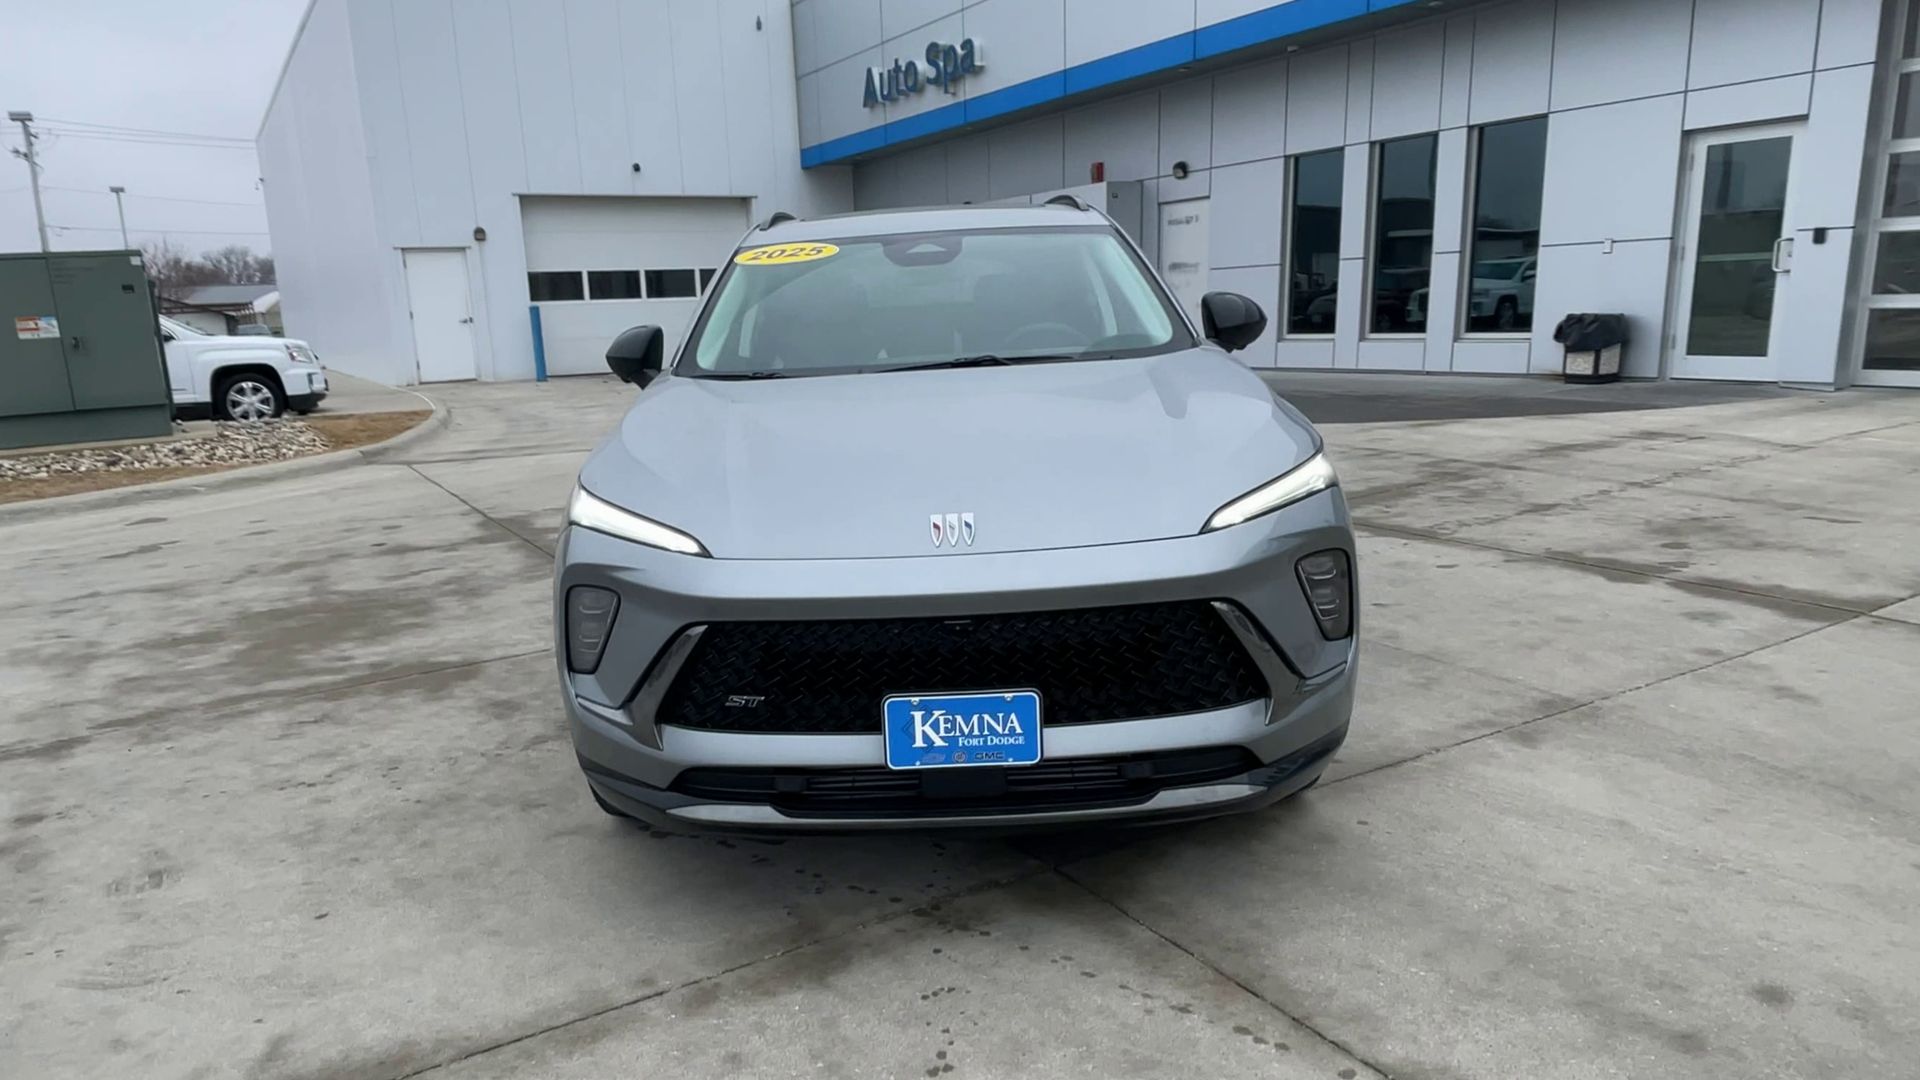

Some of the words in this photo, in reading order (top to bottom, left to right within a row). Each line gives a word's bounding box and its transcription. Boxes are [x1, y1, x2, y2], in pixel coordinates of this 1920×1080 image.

[863, 58, 922, 108] Auto
[926, 38, 984, 95] Spa
[749, 245, 828, 262] 2025
[725, 695, 765, 707] ST
[910, 710, 1023, 748] KEMNA
[958, 736, 985, 747] FORT
[987, 735, 1025, 747] DODGE
[974, 752, 1004, 761] GMC
